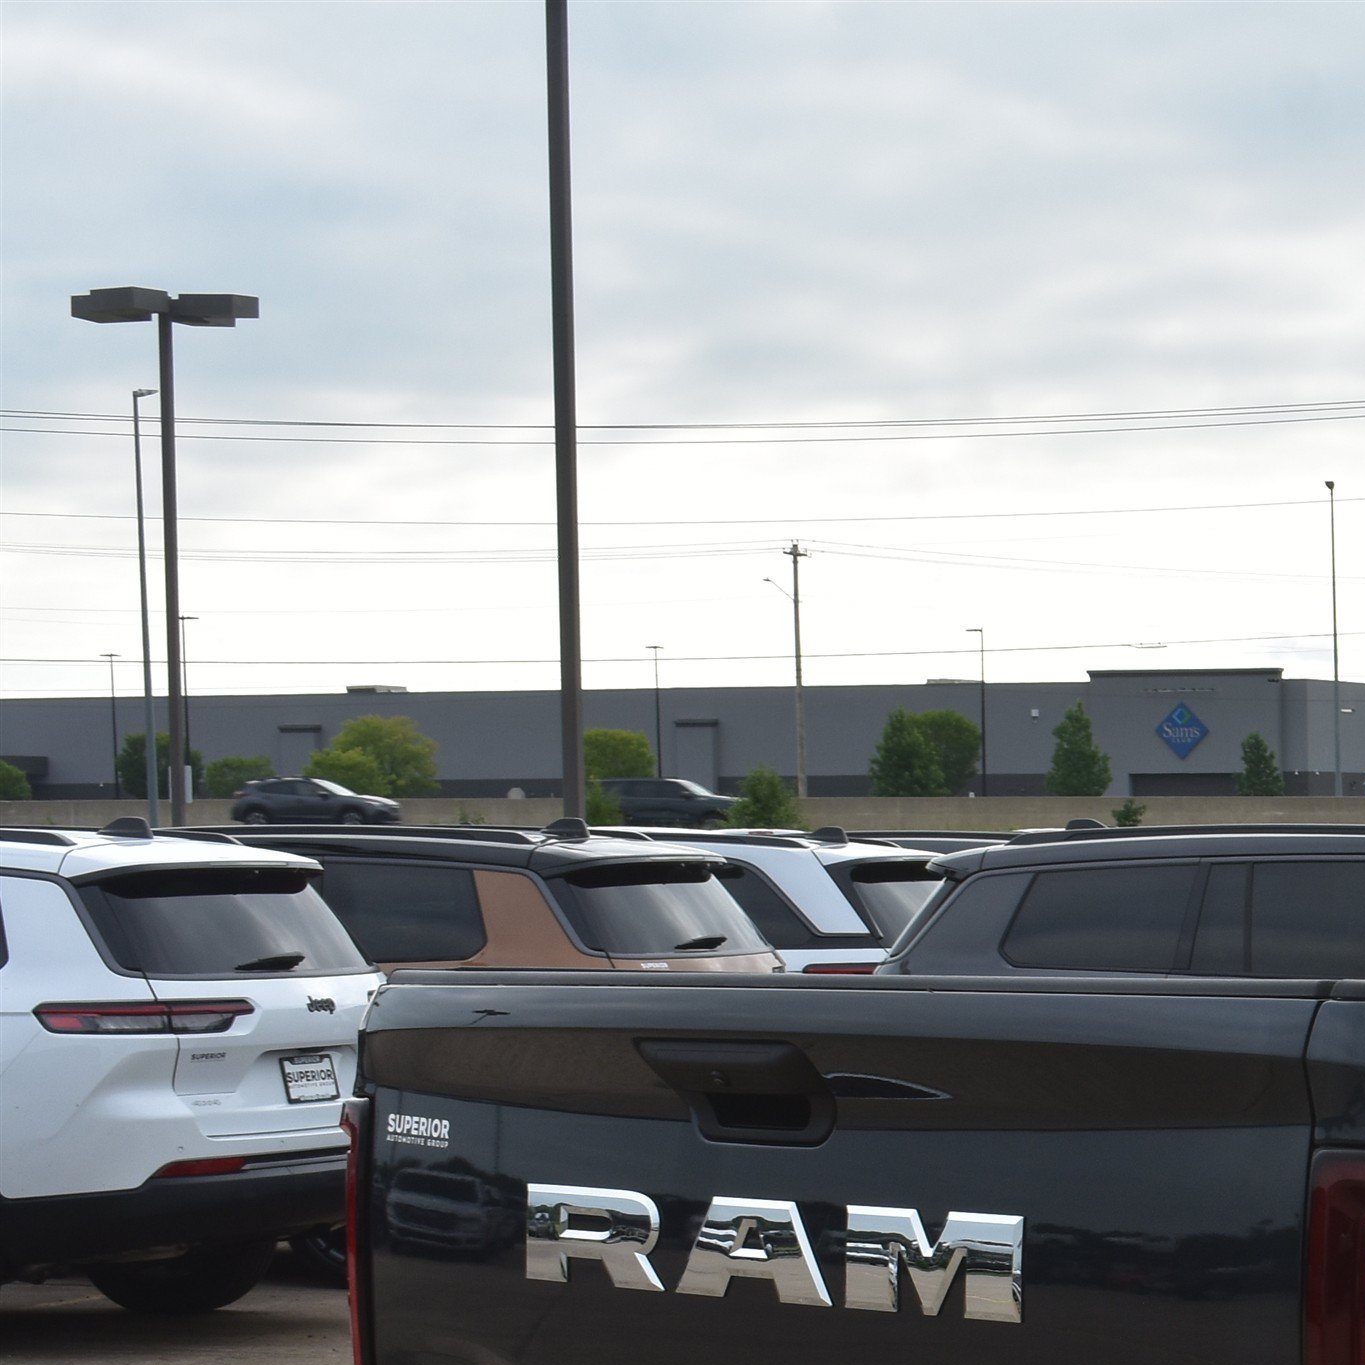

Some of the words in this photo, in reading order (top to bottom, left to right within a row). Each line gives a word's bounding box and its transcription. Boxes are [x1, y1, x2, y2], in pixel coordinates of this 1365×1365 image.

[307, 995, 336, 1015] Jeep
[286, 1069, 335, 1083] SUPERIOR
[387, 1113, 450, 1139] SUPERIOR
[386, 1134, 425, 1146] AUTOMOTIVE
[427, 1138, 449, 1149] GROUP
[526, 1183, 1025, 1323] RAM
